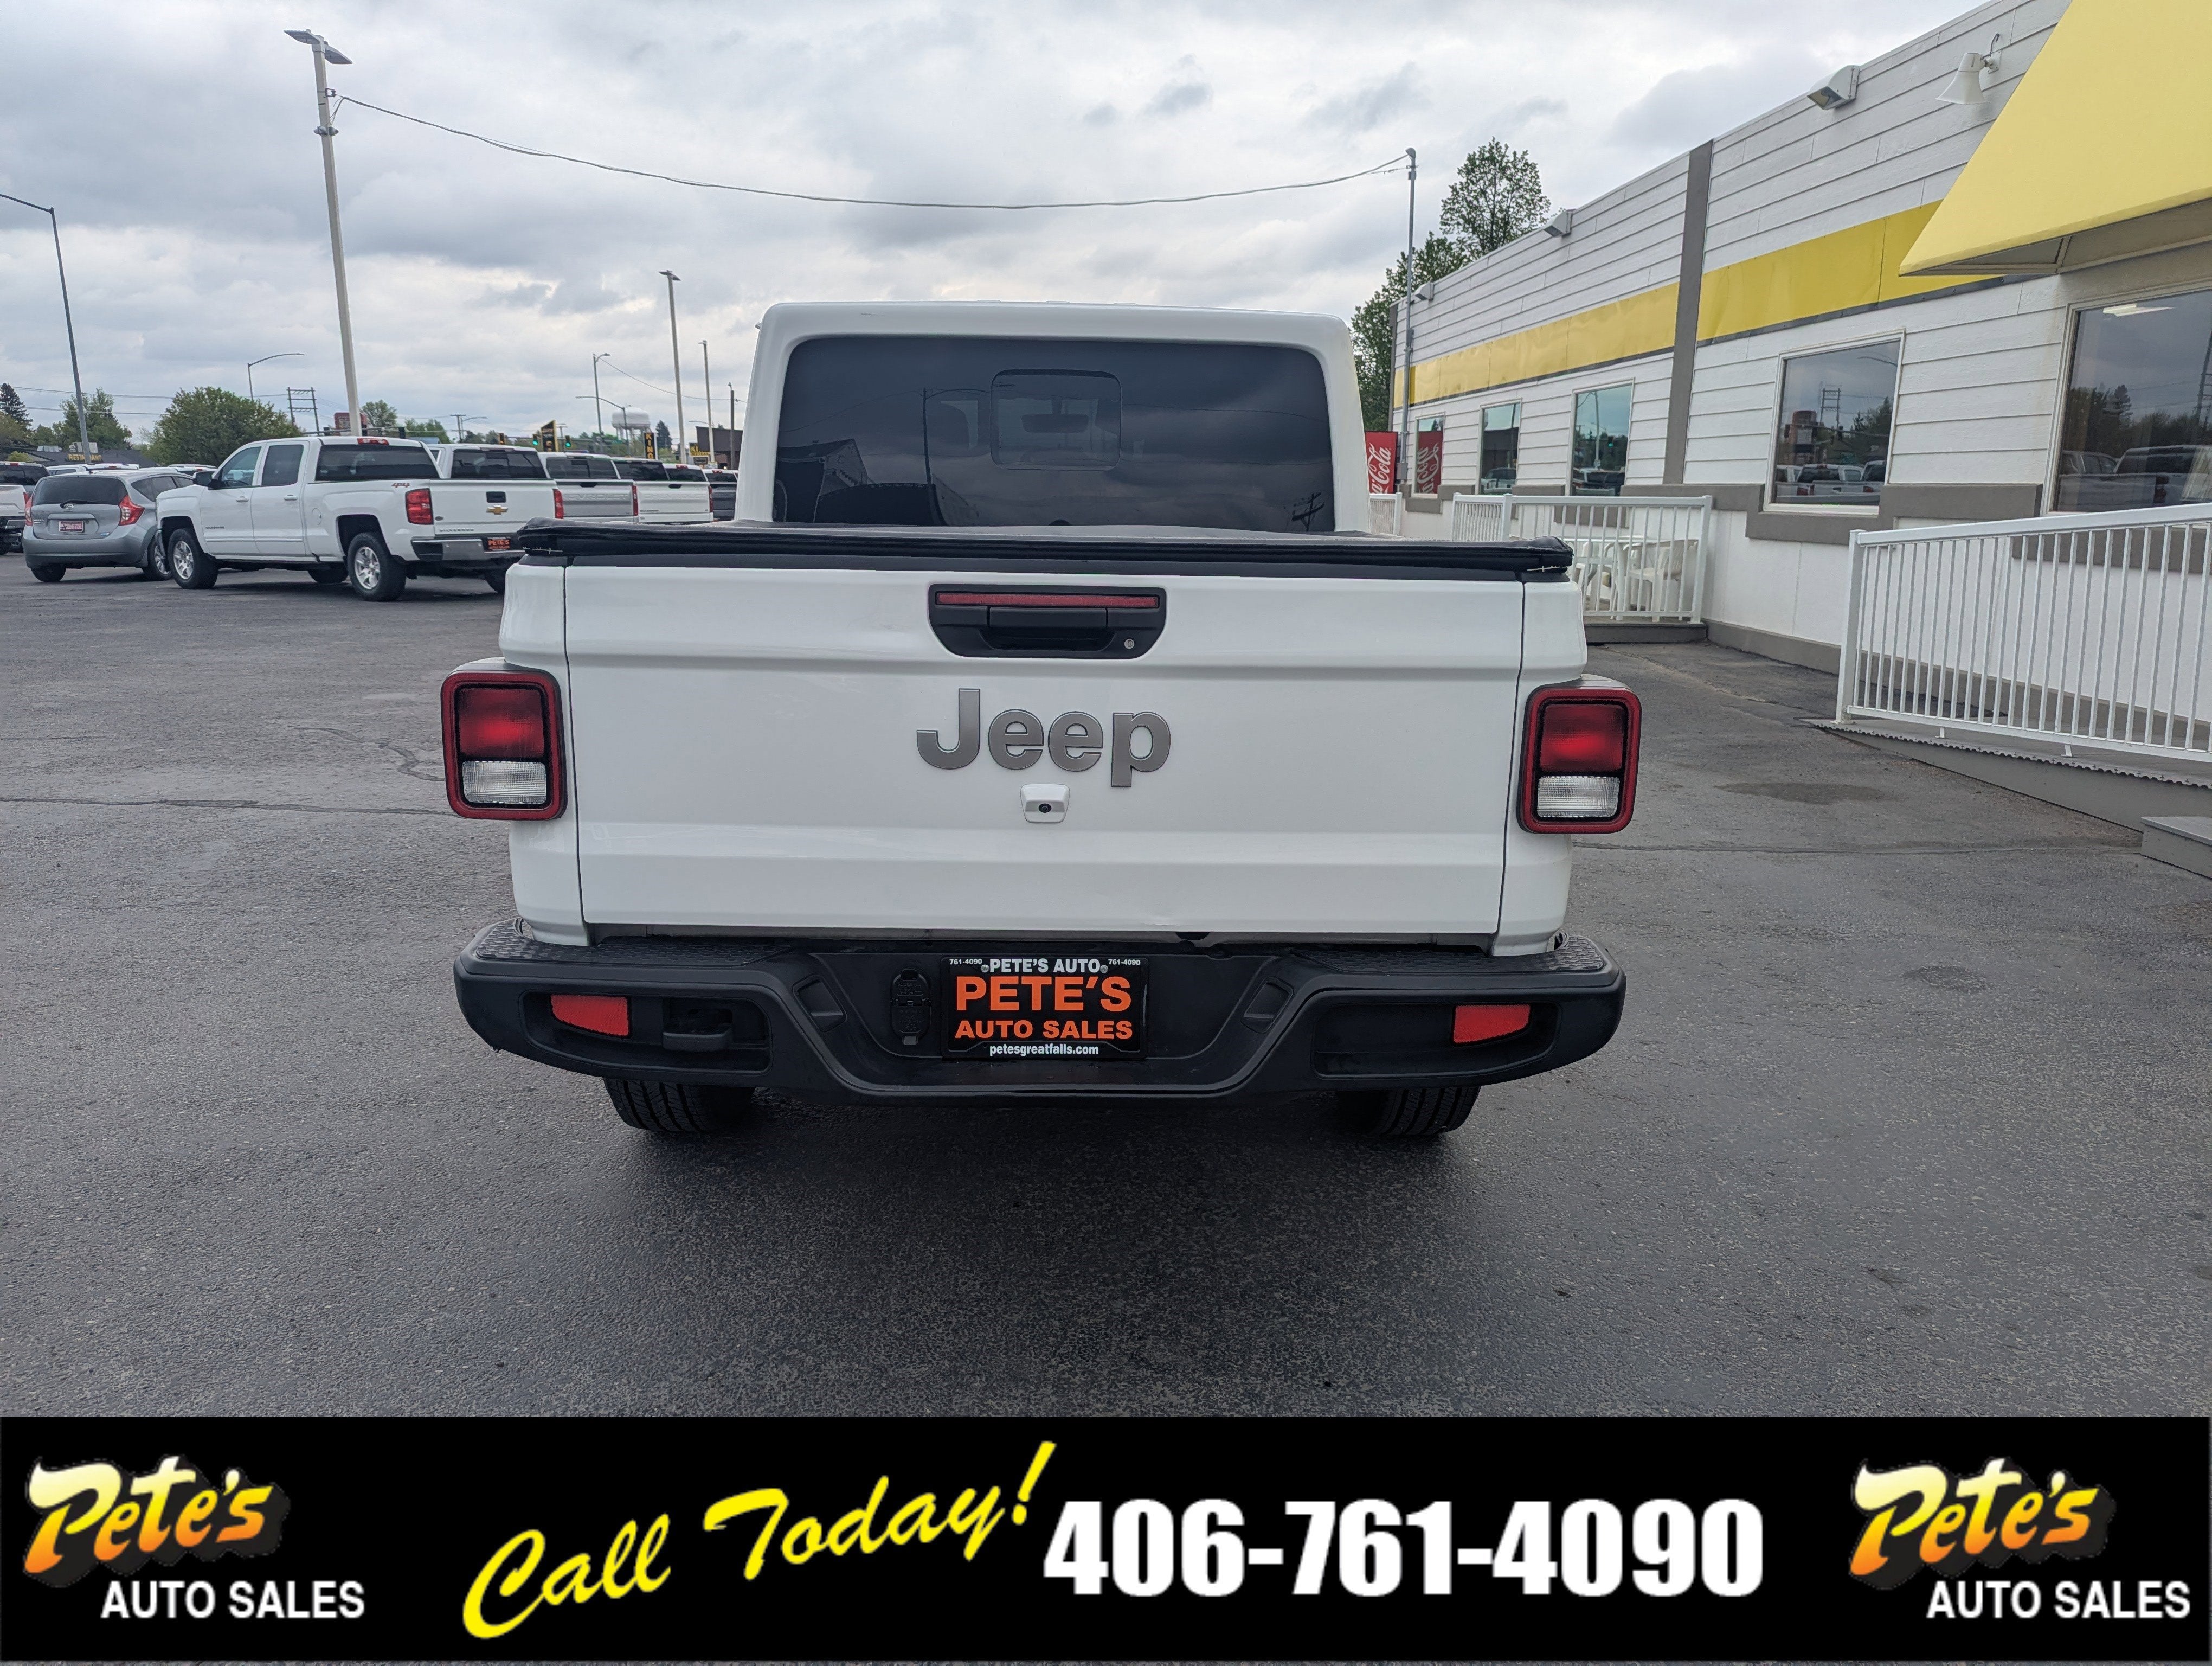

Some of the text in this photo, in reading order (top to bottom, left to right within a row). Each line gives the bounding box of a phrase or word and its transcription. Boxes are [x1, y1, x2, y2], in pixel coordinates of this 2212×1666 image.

[646, 433, 654, 460] KING
[916, 688, 1171, 787] Jeep
[989, 958, 1100, 973] PETE'S AUTO
[956, 976, 1131, 1011] PETE'S
[955, 1020, 1133, 1039] AUTO SALES
[989, 1043, 1099, 1057] petesgreatfalls.com
